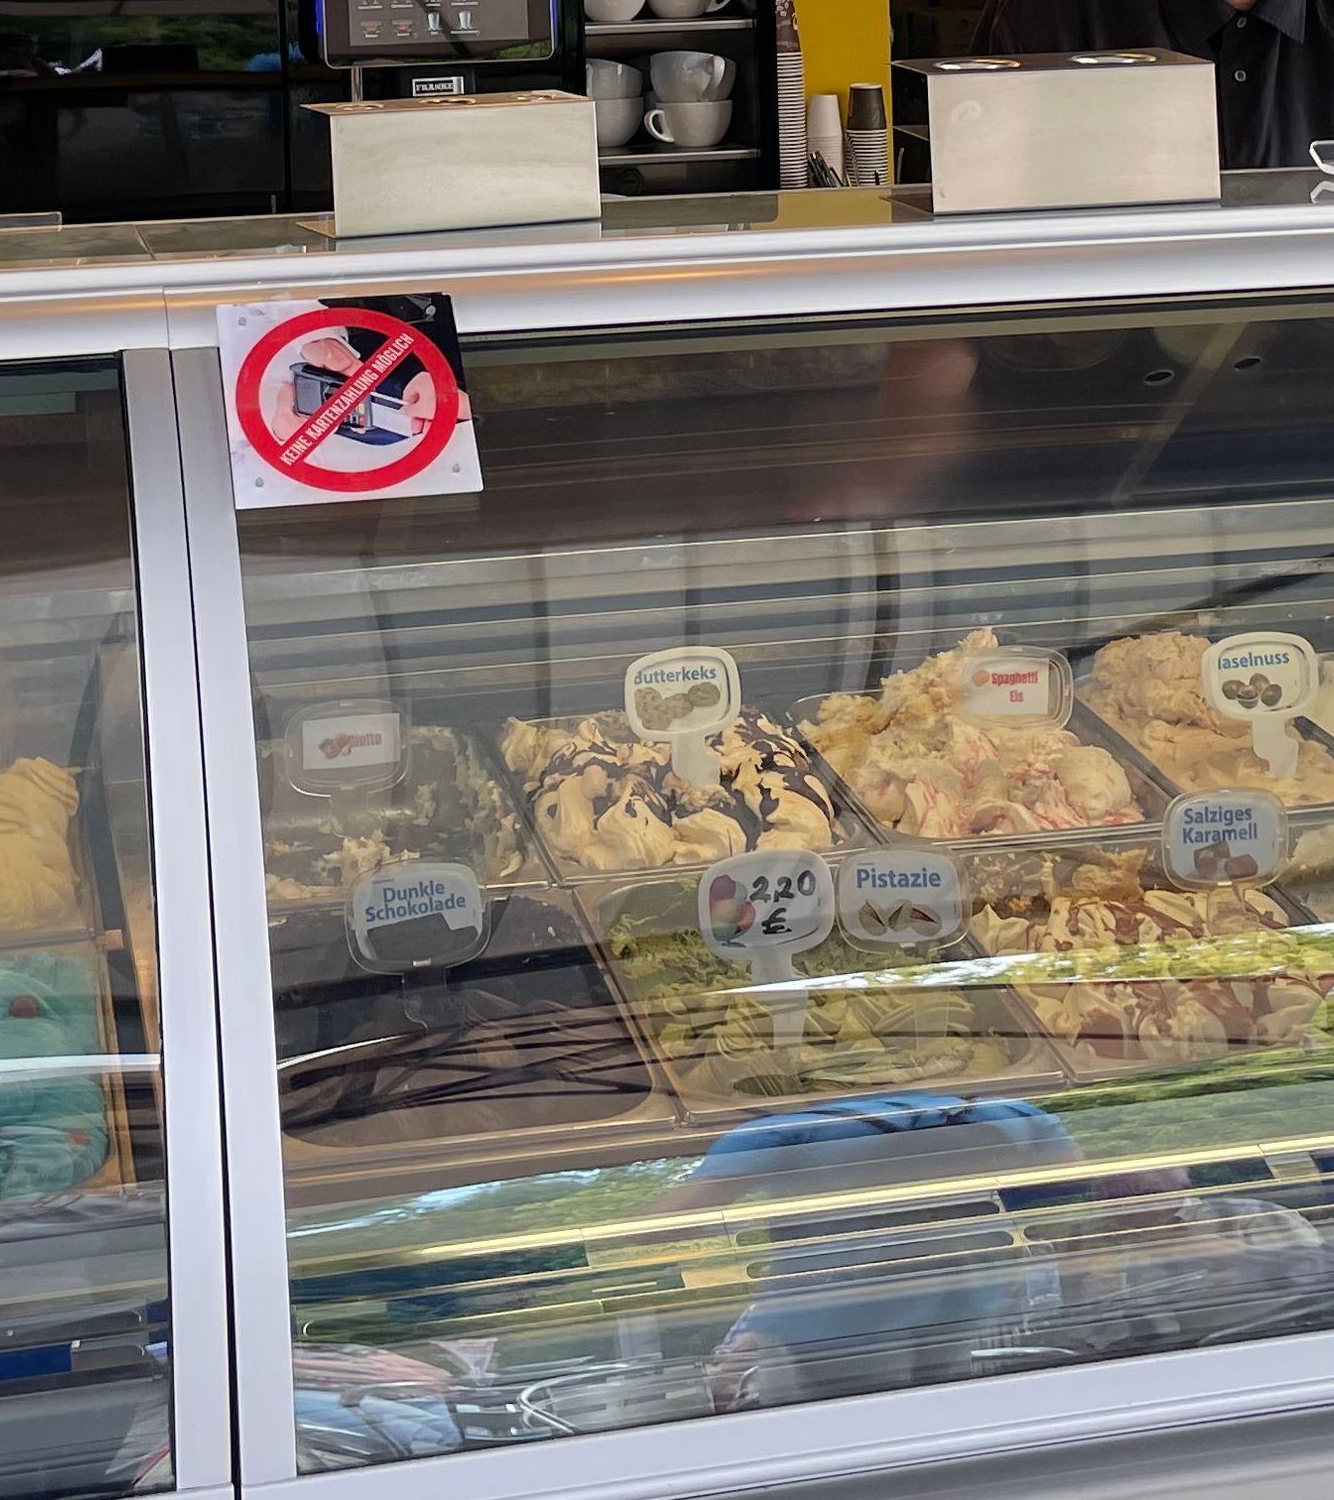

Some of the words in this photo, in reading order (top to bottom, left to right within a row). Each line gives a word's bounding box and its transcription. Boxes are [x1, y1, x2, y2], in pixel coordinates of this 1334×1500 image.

[279, 434, 314, 467] KEINE
[306, 368, 379, 443] KARTENZAHLUNG
[371, 332, 415, 376] MÖGLICH
[634, 665, 717, 685] Butterkeks
[991, 671, 1039, 689] Spaghetti
[1009, 690, 1024, 703] Eis
[1182, 803, 1254, 827] Salziges
[1181, 822, 1259, 845] Karamell
[856, 865, 942, 891] Pistazie
[381, 879, 446, 903] Dunkle
[363, 891, 467, 924] Schokolade
